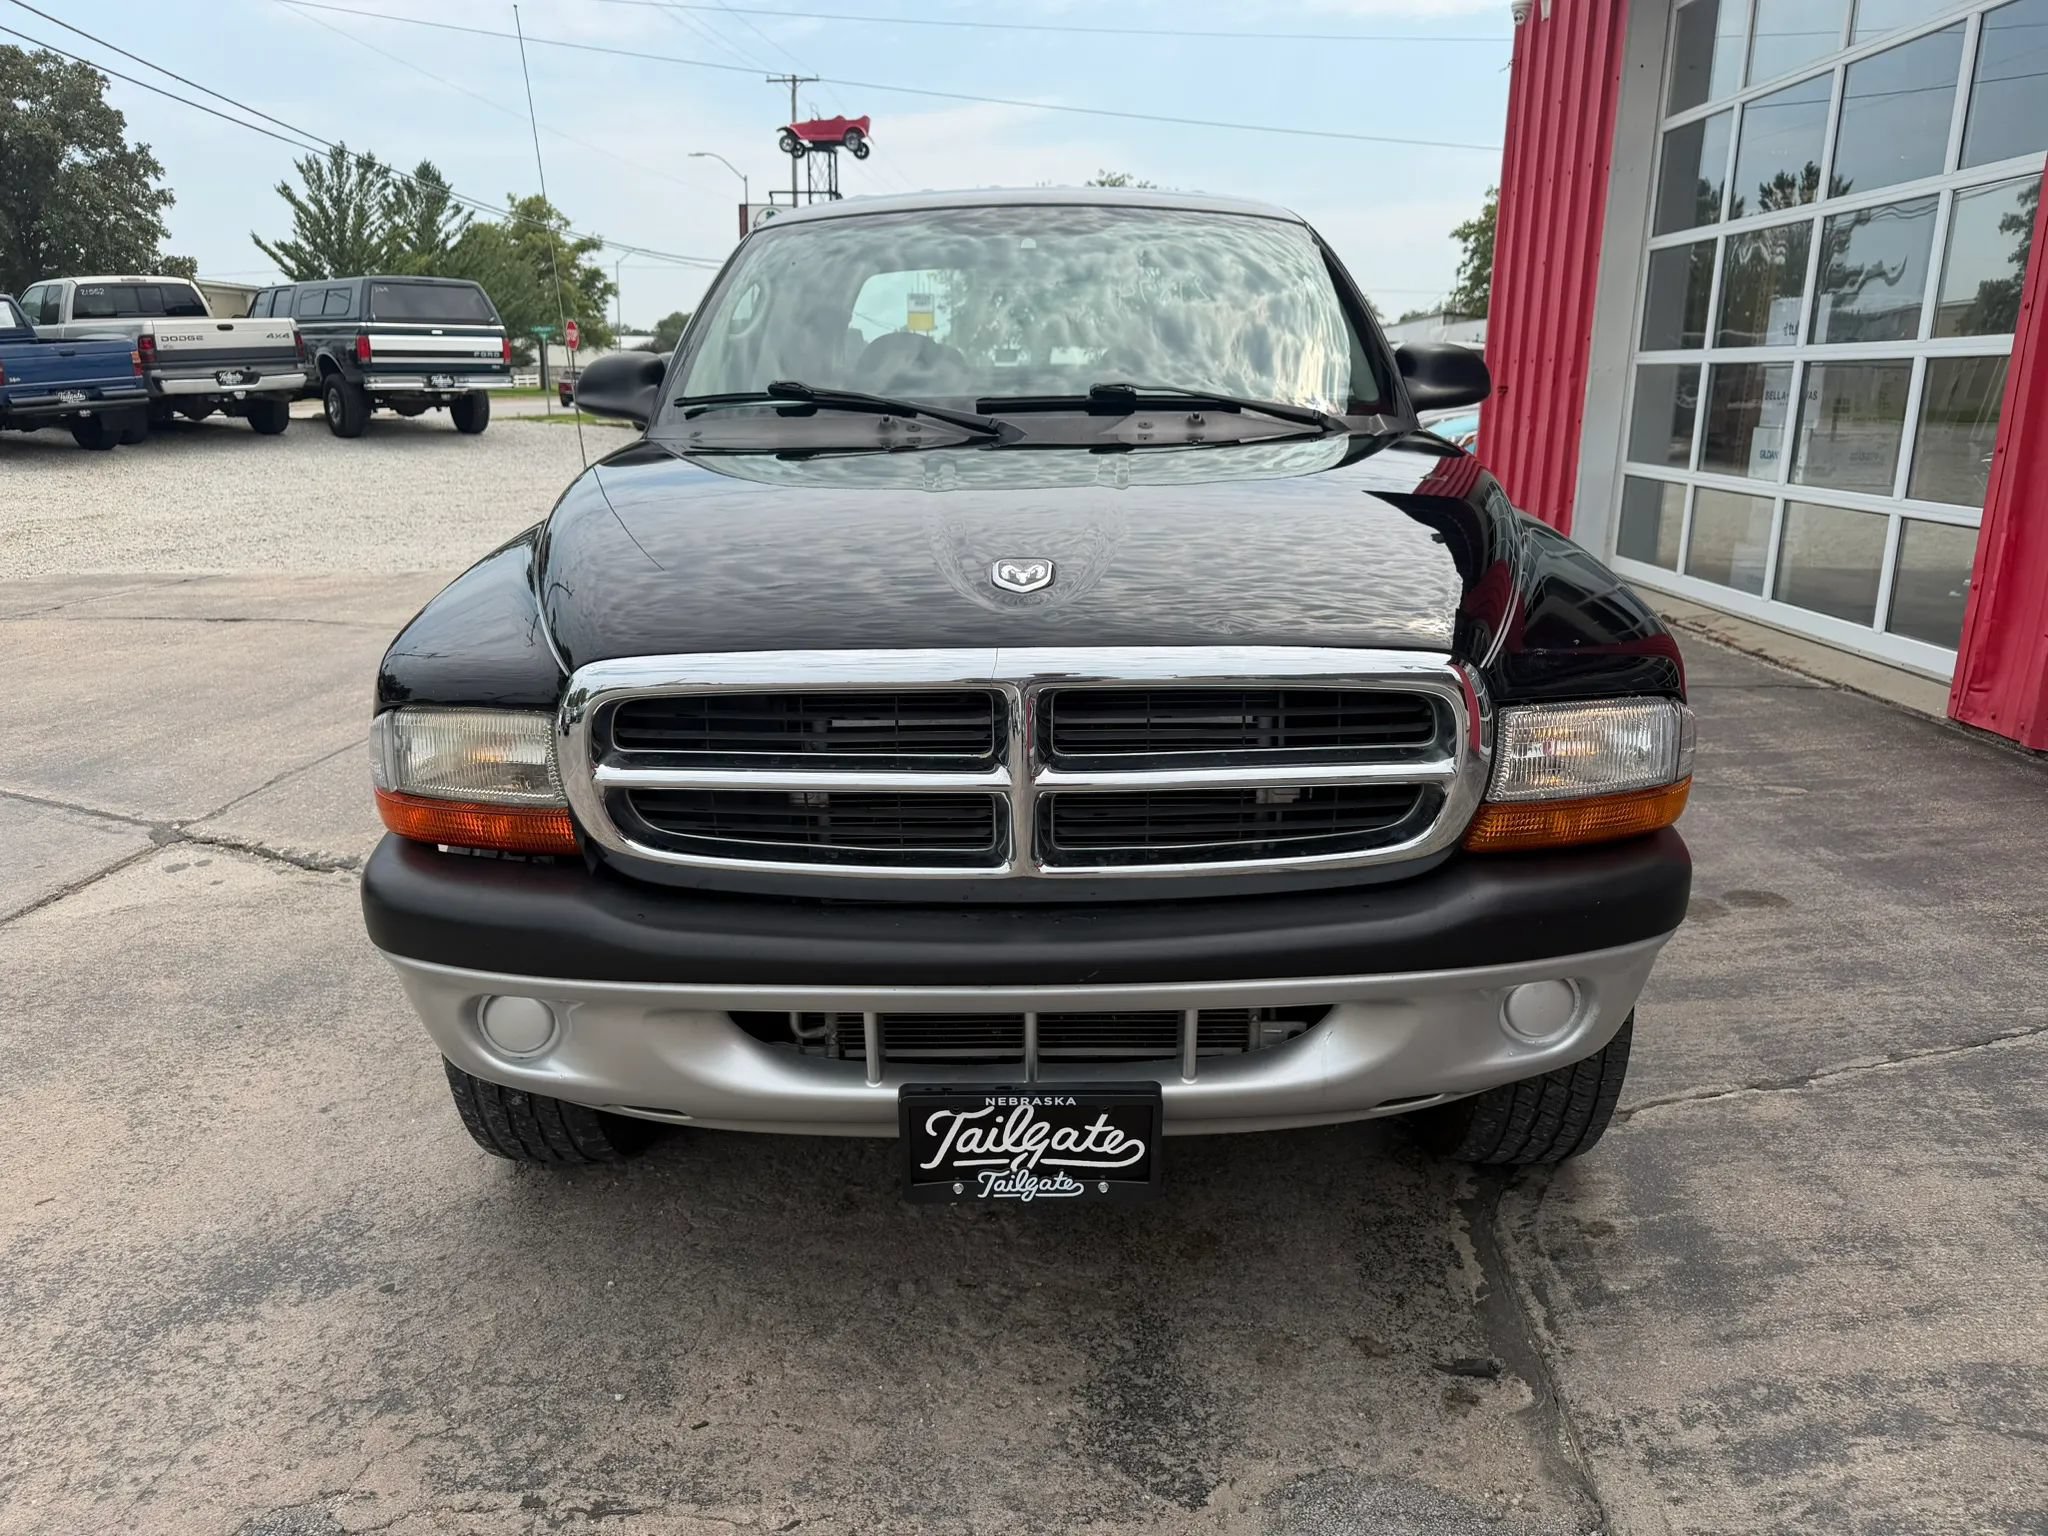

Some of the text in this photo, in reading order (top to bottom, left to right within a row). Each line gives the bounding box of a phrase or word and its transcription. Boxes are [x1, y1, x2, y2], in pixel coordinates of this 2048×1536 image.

[985, 1097, 1077, 1106] NEBRASKA
[920, 1104, 1146, 1172] Tailgate
[977, 1168, 1085, 1202] Tailgate
